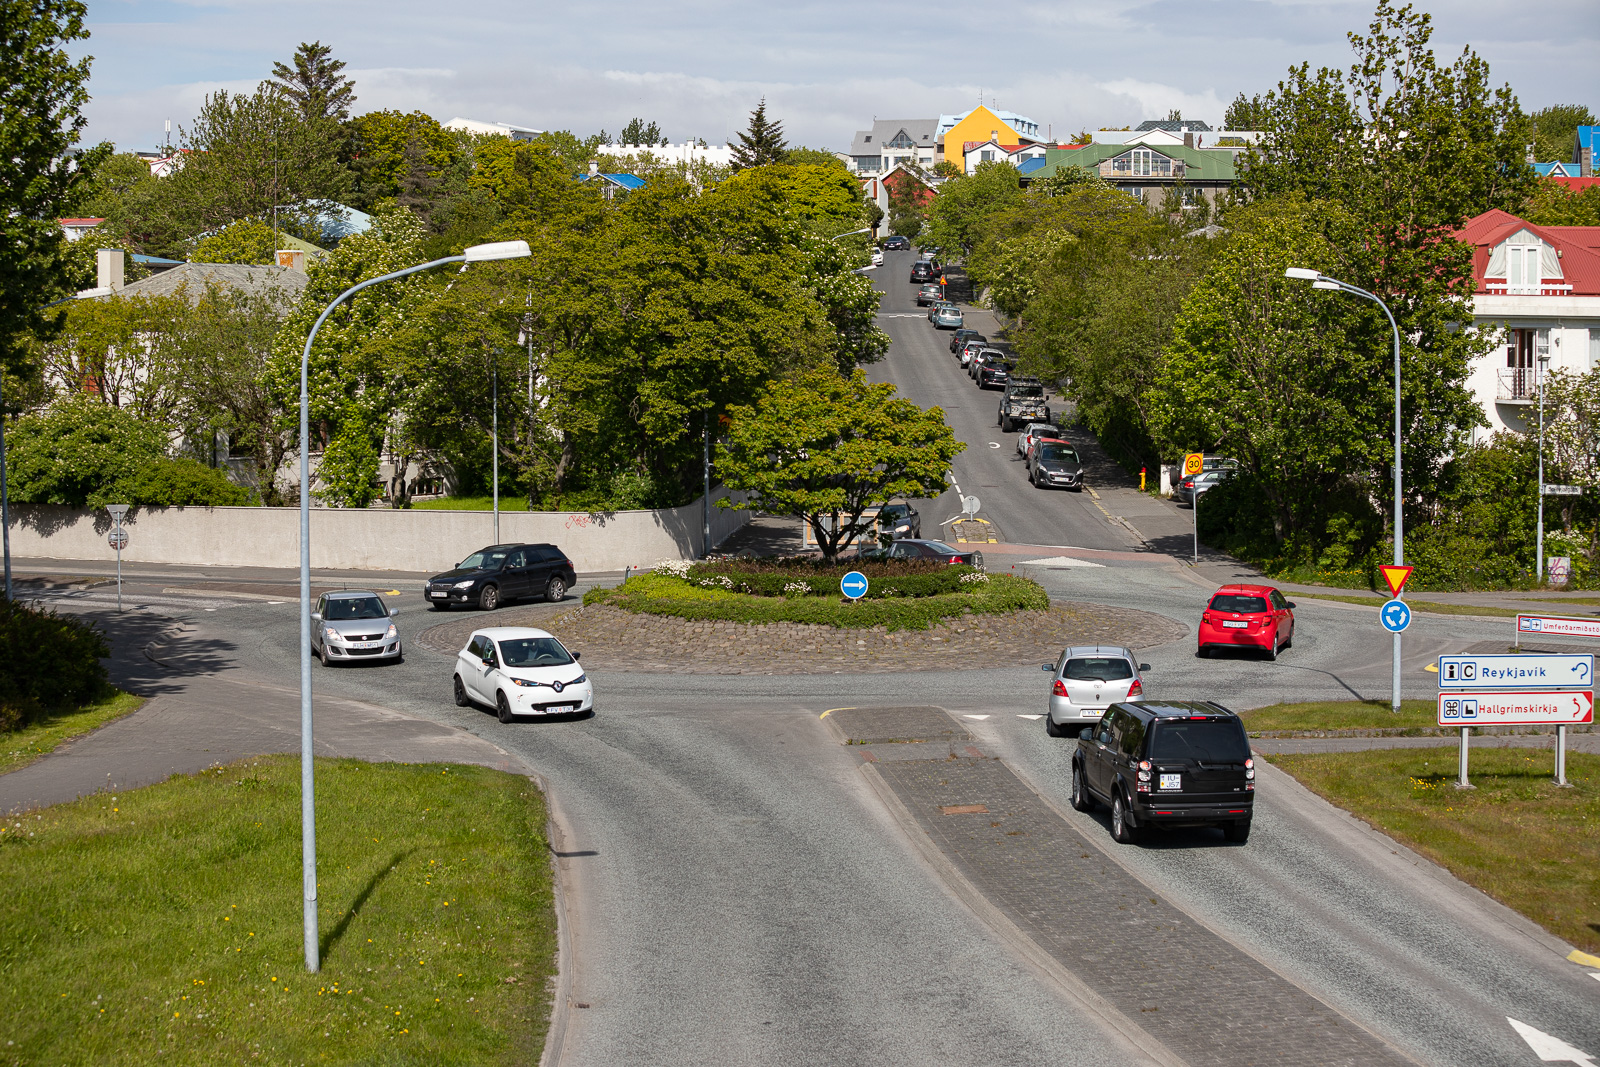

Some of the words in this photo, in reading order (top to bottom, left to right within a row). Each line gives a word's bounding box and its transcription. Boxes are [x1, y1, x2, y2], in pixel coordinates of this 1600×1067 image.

[1189, 460, 1199, 468] 30
[1464, 665, 1473, 678] C
[1482, 666, 1546, 679] Reykjavík
